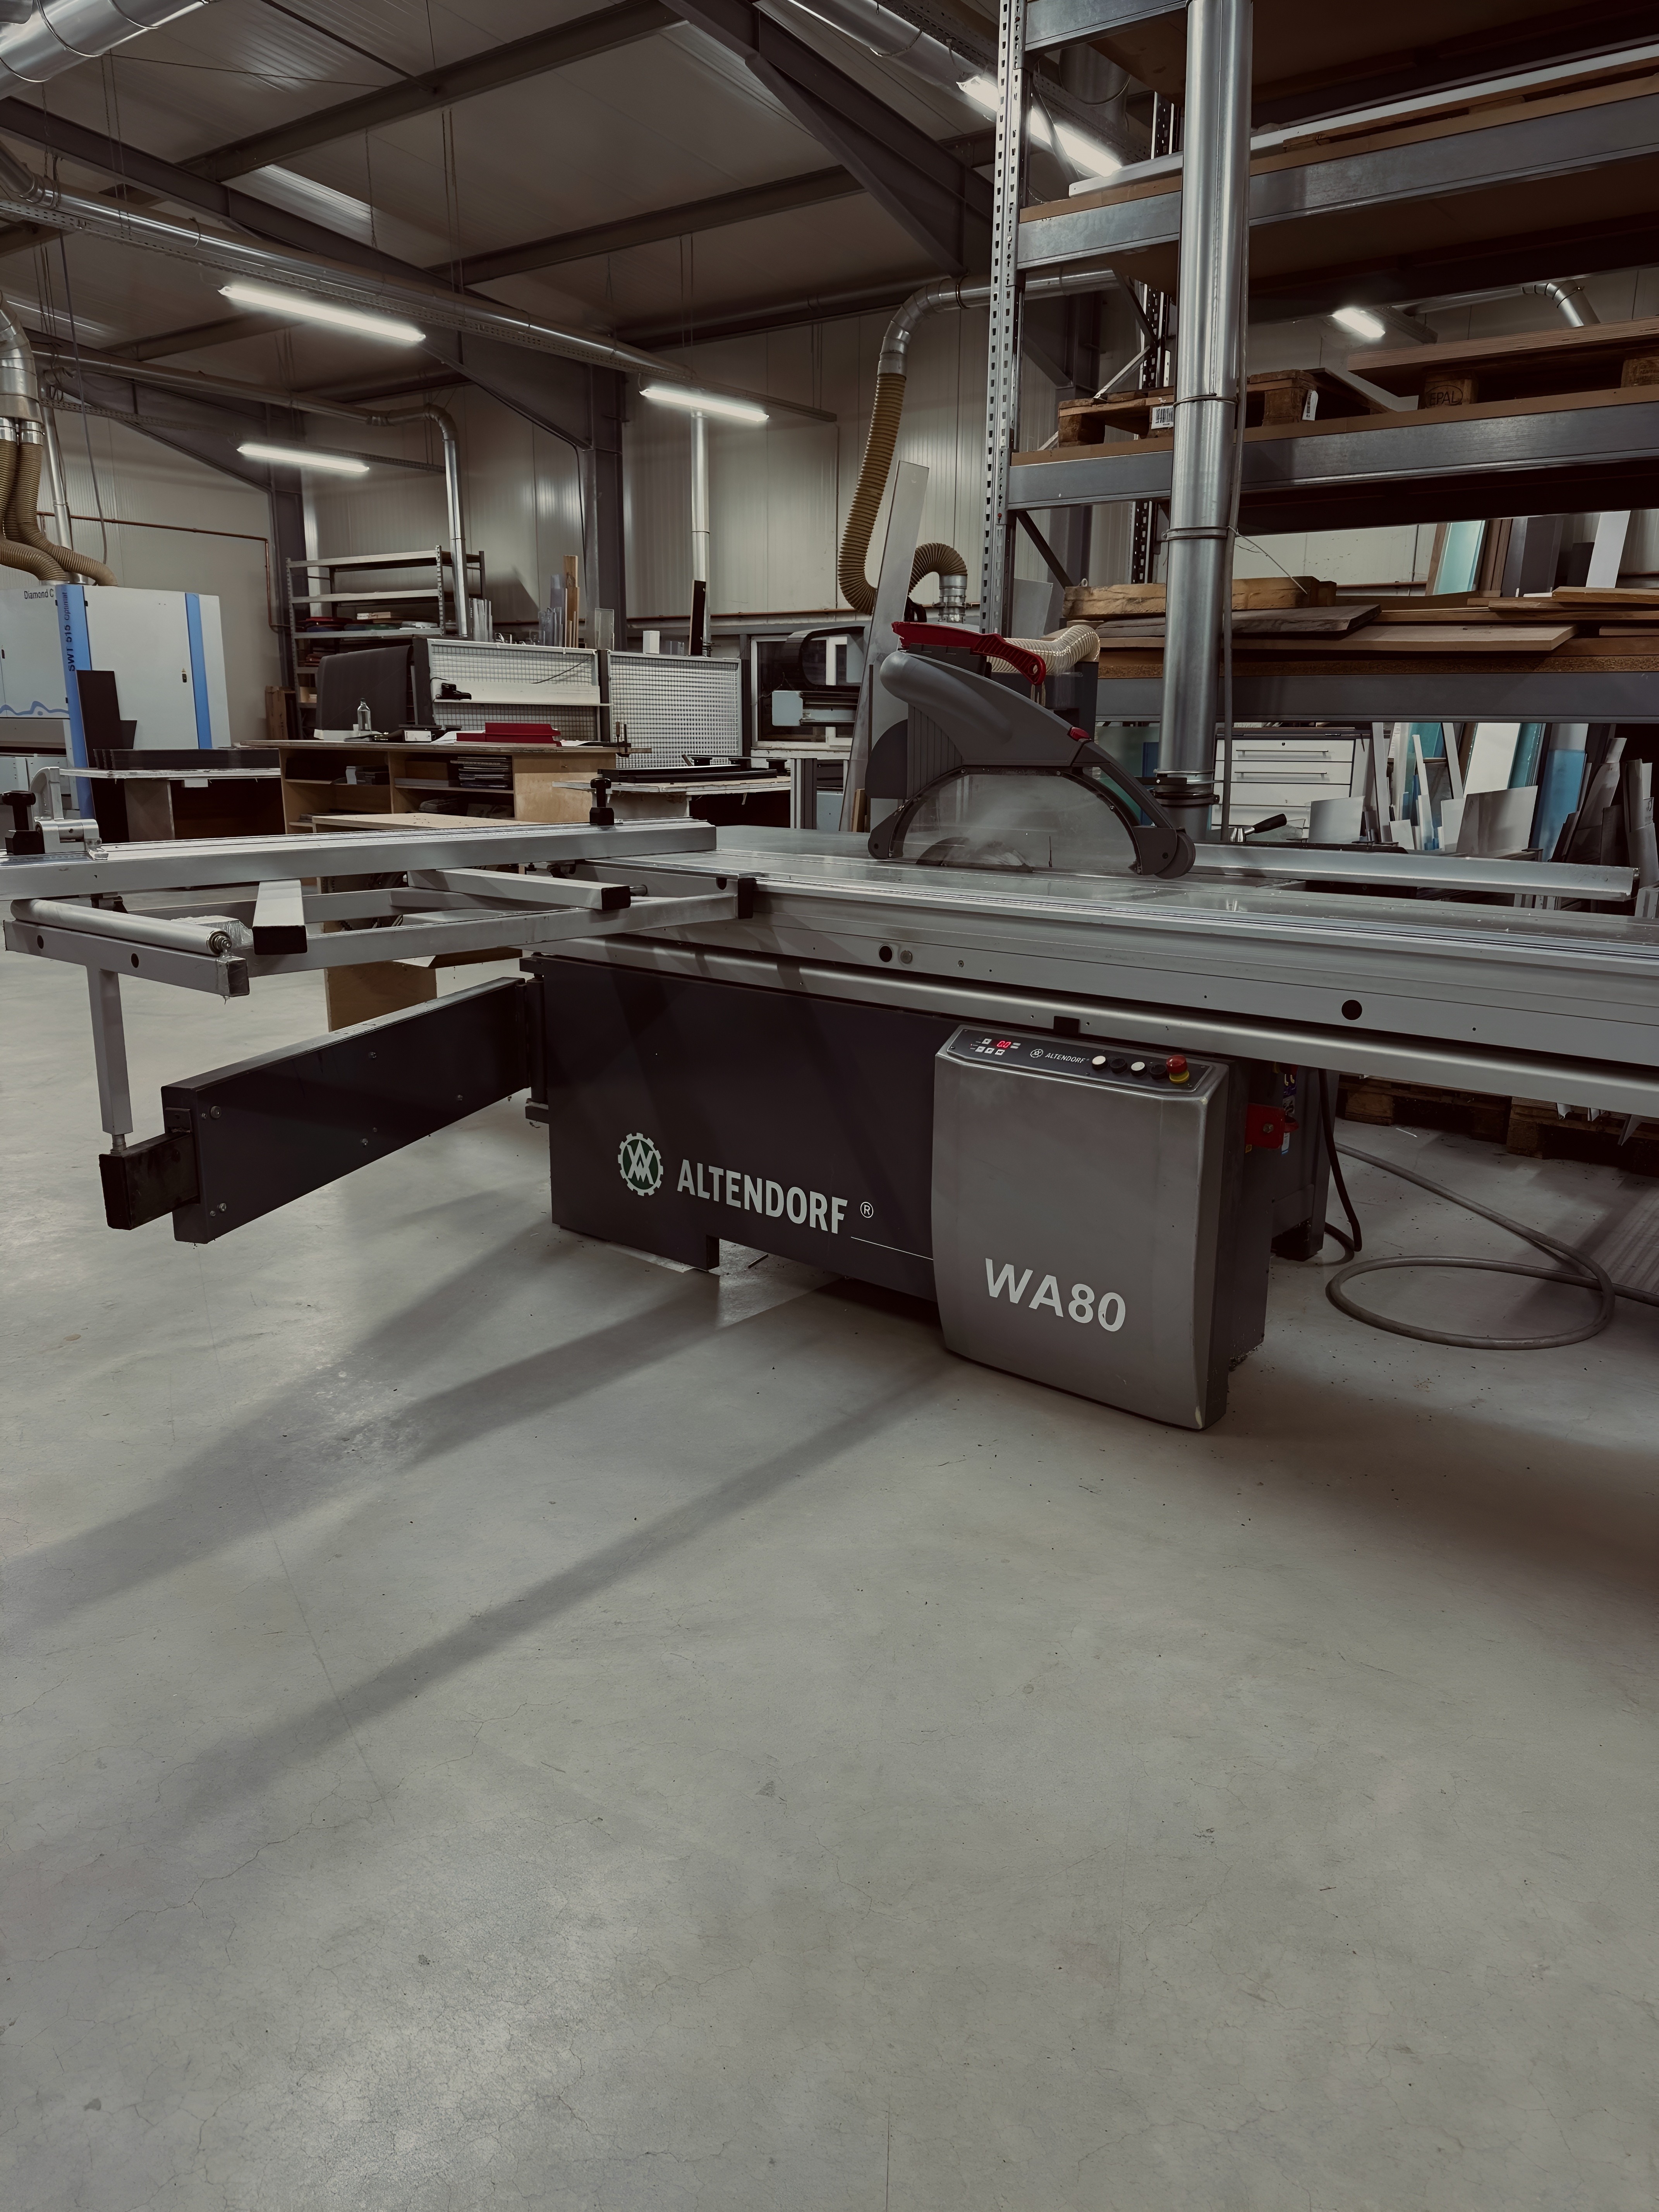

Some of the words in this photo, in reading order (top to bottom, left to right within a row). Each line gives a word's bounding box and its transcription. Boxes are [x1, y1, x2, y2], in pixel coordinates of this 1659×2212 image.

[1429, 390, 1458, 405] EPAL
[24, 589, 48, 599] Diamond
[66, 646, 76, 672] SWT
[1045, 1053, 1086, 1063] ALTENDORF
[677, 1159, 848, 1234] ALTENDORF
[985, 1258, 1126, 1332] WA80
